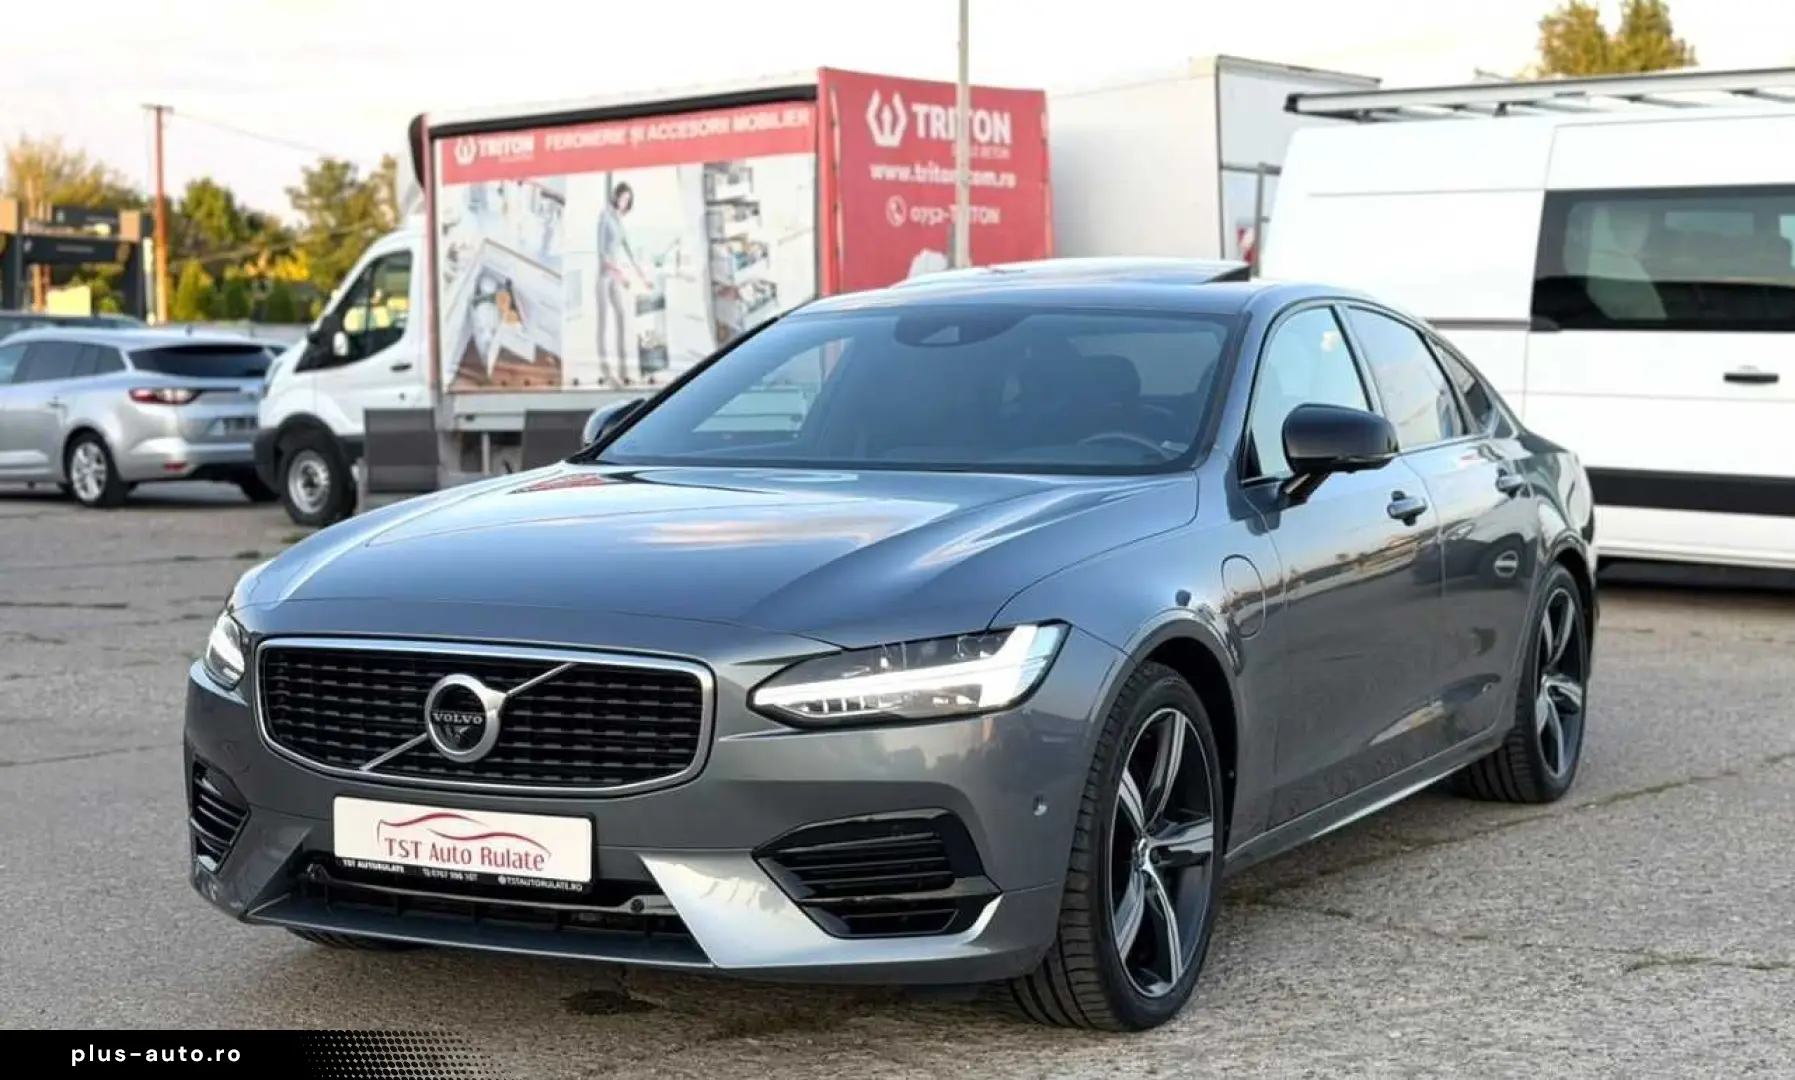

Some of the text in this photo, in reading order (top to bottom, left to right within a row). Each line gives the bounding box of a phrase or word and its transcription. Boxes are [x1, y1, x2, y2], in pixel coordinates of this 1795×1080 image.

[478, 134, 534, 157] TRITON
[647, 116, 729, 141] ACCESORII
[731, 106, 810, 132] MOBILIER
[911, 102, 1012, 144] TRION
[432, 712, 483, 725] VOLVO
[343, 859, 355, 868] TST
[357, 860, 404, 873] AUTORULATE
[384, 837, 545, 872] TST Auto Rulate
